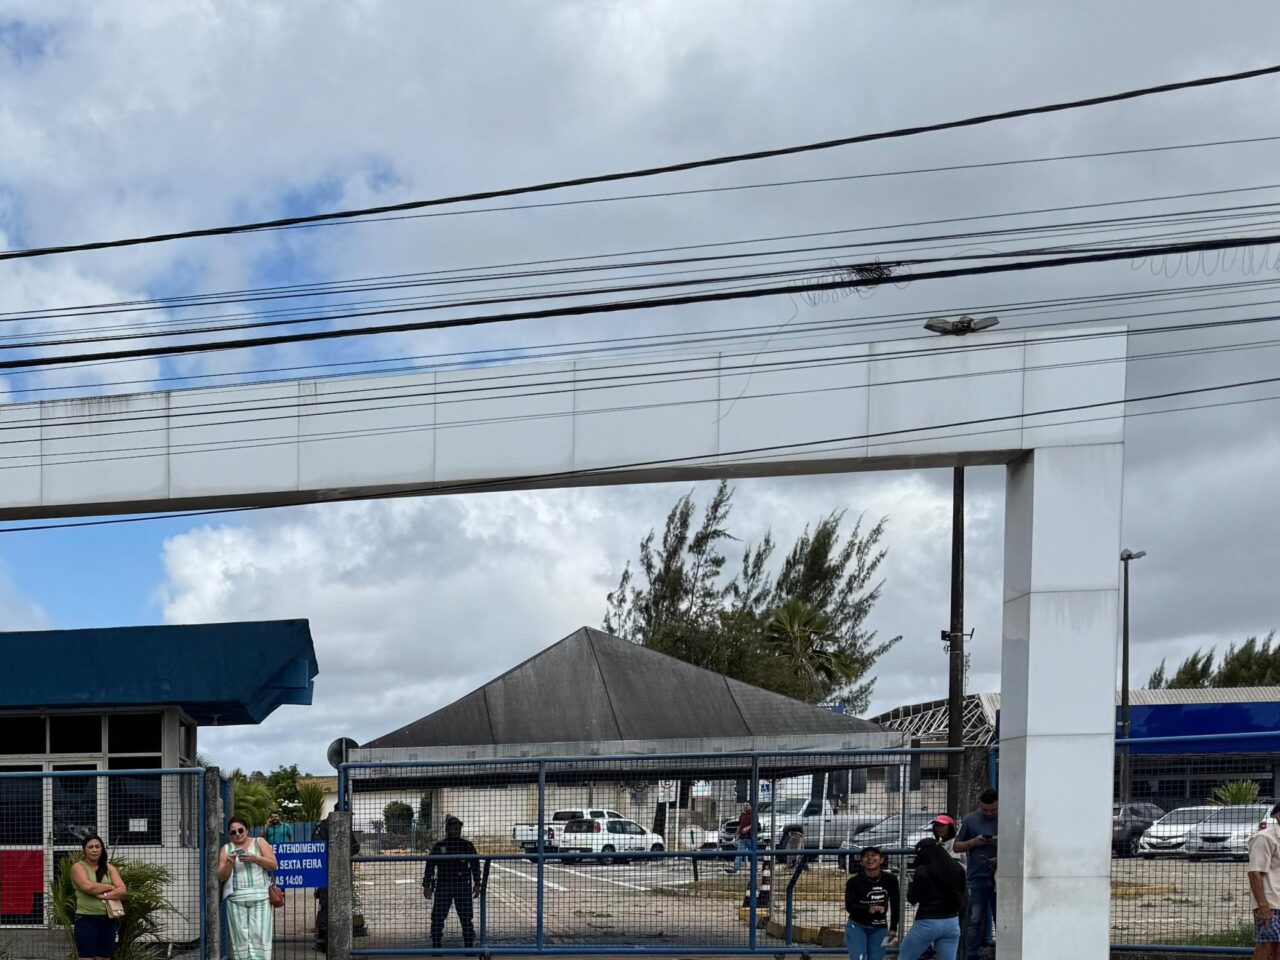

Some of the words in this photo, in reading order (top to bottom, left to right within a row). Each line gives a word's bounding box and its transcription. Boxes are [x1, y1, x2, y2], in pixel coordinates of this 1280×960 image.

[278, 843, 326, 854] ATENDIMENTO
[280, 860, 302, 870] SEXTA
[302, 859, 323, 869] FEIRA
[285, 875, 303, 885] 14:00
